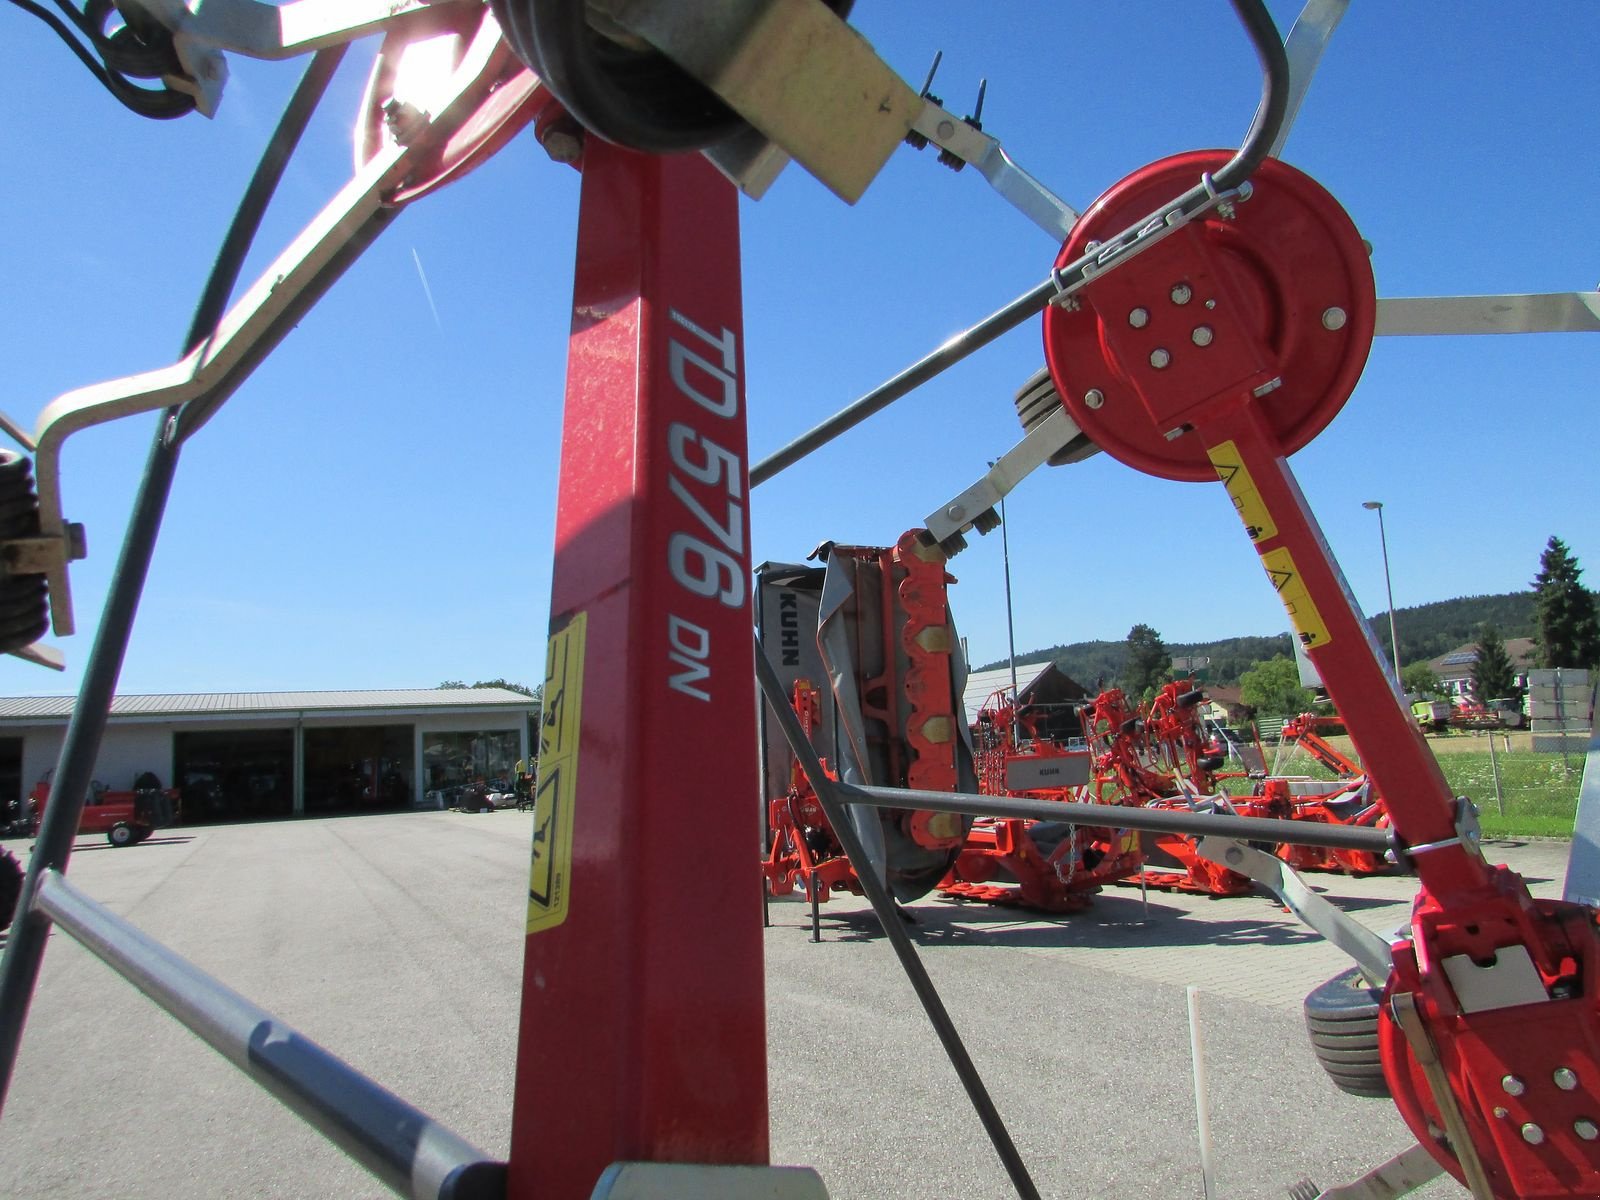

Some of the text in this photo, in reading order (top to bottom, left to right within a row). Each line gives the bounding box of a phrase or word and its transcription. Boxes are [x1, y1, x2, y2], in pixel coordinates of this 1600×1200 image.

[668, 306, 745, 702] TD 576 DN
[780, 593, 799, 666] KUHN
